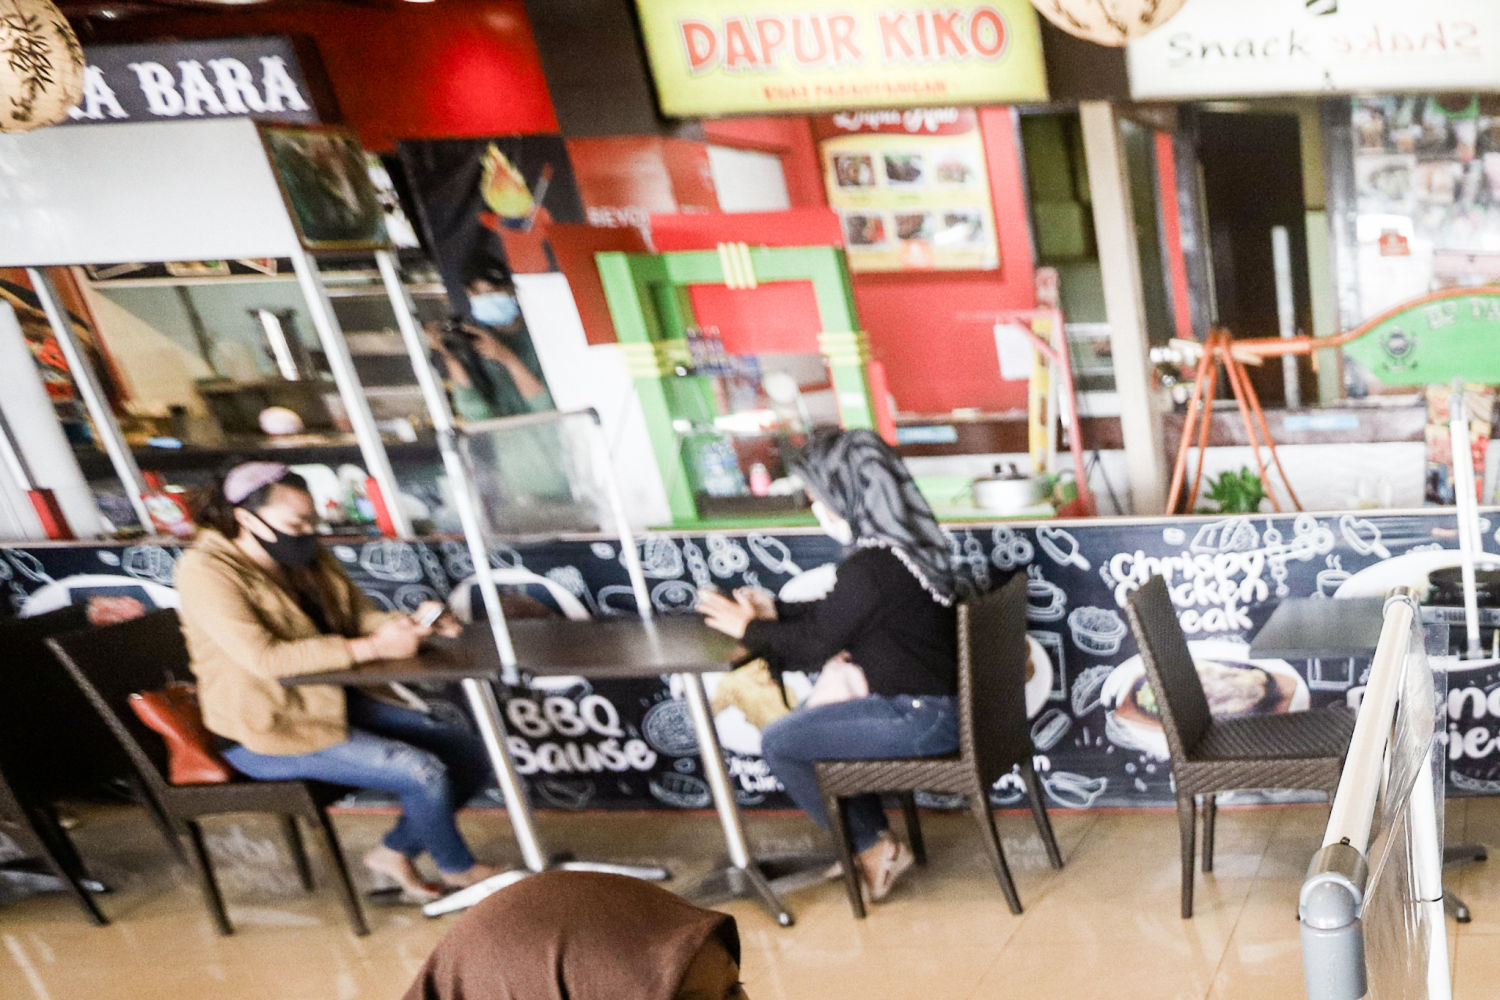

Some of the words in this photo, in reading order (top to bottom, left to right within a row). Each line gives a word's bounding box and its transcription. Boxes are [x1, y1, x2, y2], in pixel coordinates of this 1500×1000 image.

[681, 13, 862, 68] DAPUR
[876, 8, 1006, 59] KIKO
[1168, 27, 1308, 60] Snack
[126, 54, 311, 118] BARA
[1113, 577, 1270, 609] Ccken
[506, 694, 626, 738] BBQ
